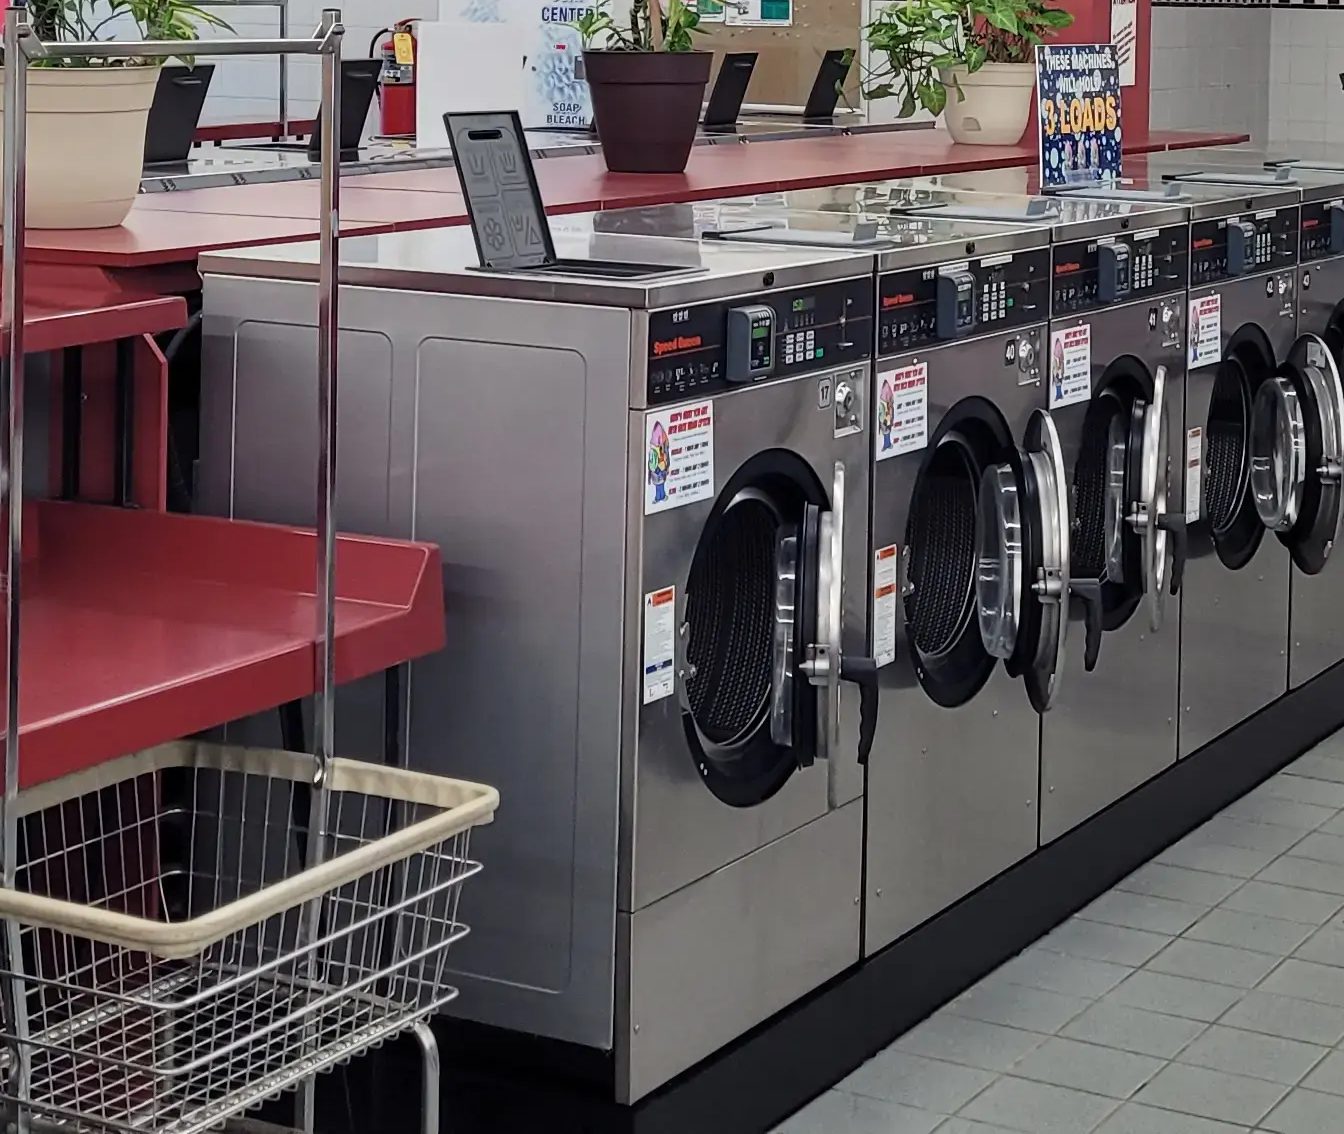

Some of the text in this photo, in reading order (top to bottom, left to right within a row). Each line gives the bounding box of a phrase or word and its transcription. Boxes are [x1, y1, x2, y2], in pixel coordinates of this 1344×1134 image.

[1045, 54, 1070, 70] THESE
[1058, 76, 1076, 93] WILL
[553, 103, 580, 112] SOAP
[546, 115, 585, 125] BLEACH
[1045, 96, 1116, 136] 3 LOADS
[1267, 281, 1273, 292] 42
[1303, 275, 1310, 286] 43
[1149, 313, 1156, 326] 41
[654, 335, 701, 355] Speed Queen
[1006, 344, 1015, 360] 40
[820, 386, 829, 400] 17
